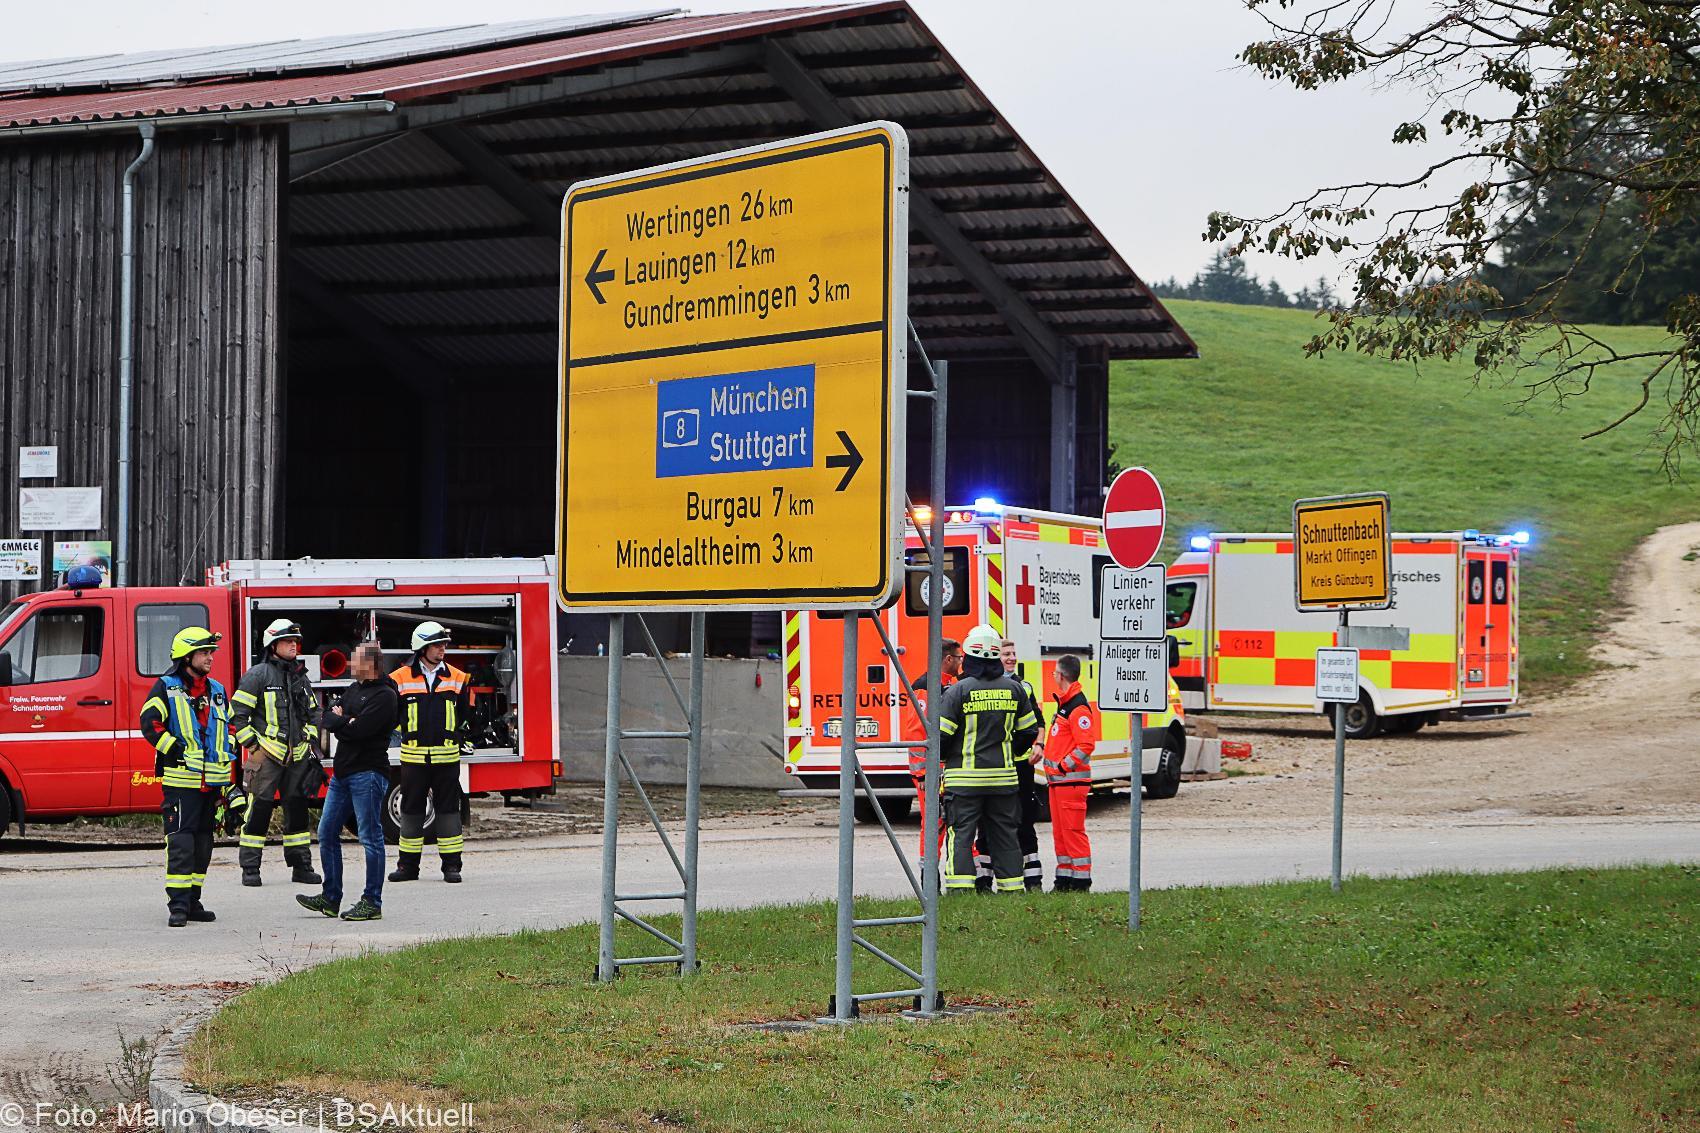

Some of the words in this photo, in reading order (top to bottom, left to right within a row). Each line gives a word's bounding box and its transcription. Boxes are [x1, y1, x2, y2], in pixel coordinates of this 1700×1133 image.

[626, 202, 730, 241] Wertingen
[740, 188, 765, 222] 26
[769, 195, 793, 217] km
[624, 249, 716, 285] Lauingen
[727, 239, 747, 271] 12
[751, 245, 775, 267] km
[623, 283, 797, 329] Gundremmingen
[808, 273, 820, 304] 3
[825, 280, 850, 303] km
[711, 381, 807, 417] München
[676, 417, 685, 439] 8
[710, 427, 806, 466] Stuttgart
[687, 491, 761, 528] Burgau
[772, 486, 784, 517] 7
[789, 494, 814, 517] km
[1303, 518, 1380, 545] Schnuttenbach
[0, 542, 39, 551] EMMELE
[616, 535, 761, 568] Mindelaltheim
[772, 533, 784, 564] 3
[788, 541, 813, 563] km
[1306, 549, 1333, 565] Markt
[1336, 547, 1377, 565] Offingen
[1039, 566, 1081, 587] Bayerisches
[1113, 574, 1153, 590] Linien-
[1311, 575, 1332, 588] Kreis
[1335, 573, 1374, 588] Günzburg
[1392, 570, 1441, 582] risches
[1039, 587, 1060, 605] Rotes
[1110, 595, 1156, 611] verkehr
[1040, 608, 1061, 625] Kreuz
[1122, 615, 1144, 632] frei
[1245, 639, 1263, 650] 112
[1105, 644, 1141, 663] Anlieger
[1145, 644, 1161, 660] frei
[1116, 666, 1148, 681] Hausnr.
[31, 695, 67, 703] Feuerwehr
[813, 692, 909, 708] RETUNGS
[970, 689, 1012, 701] FEUERWEHR
[1114, 689, 1120, 703] 4
[1124, 688, 1140, 704] und
[1143, 688, 1149, 704] 6
[12, 704, 64, 712] Schnuttenbach
[963, 700, 1019, 713] SCHNUTTENBACH
